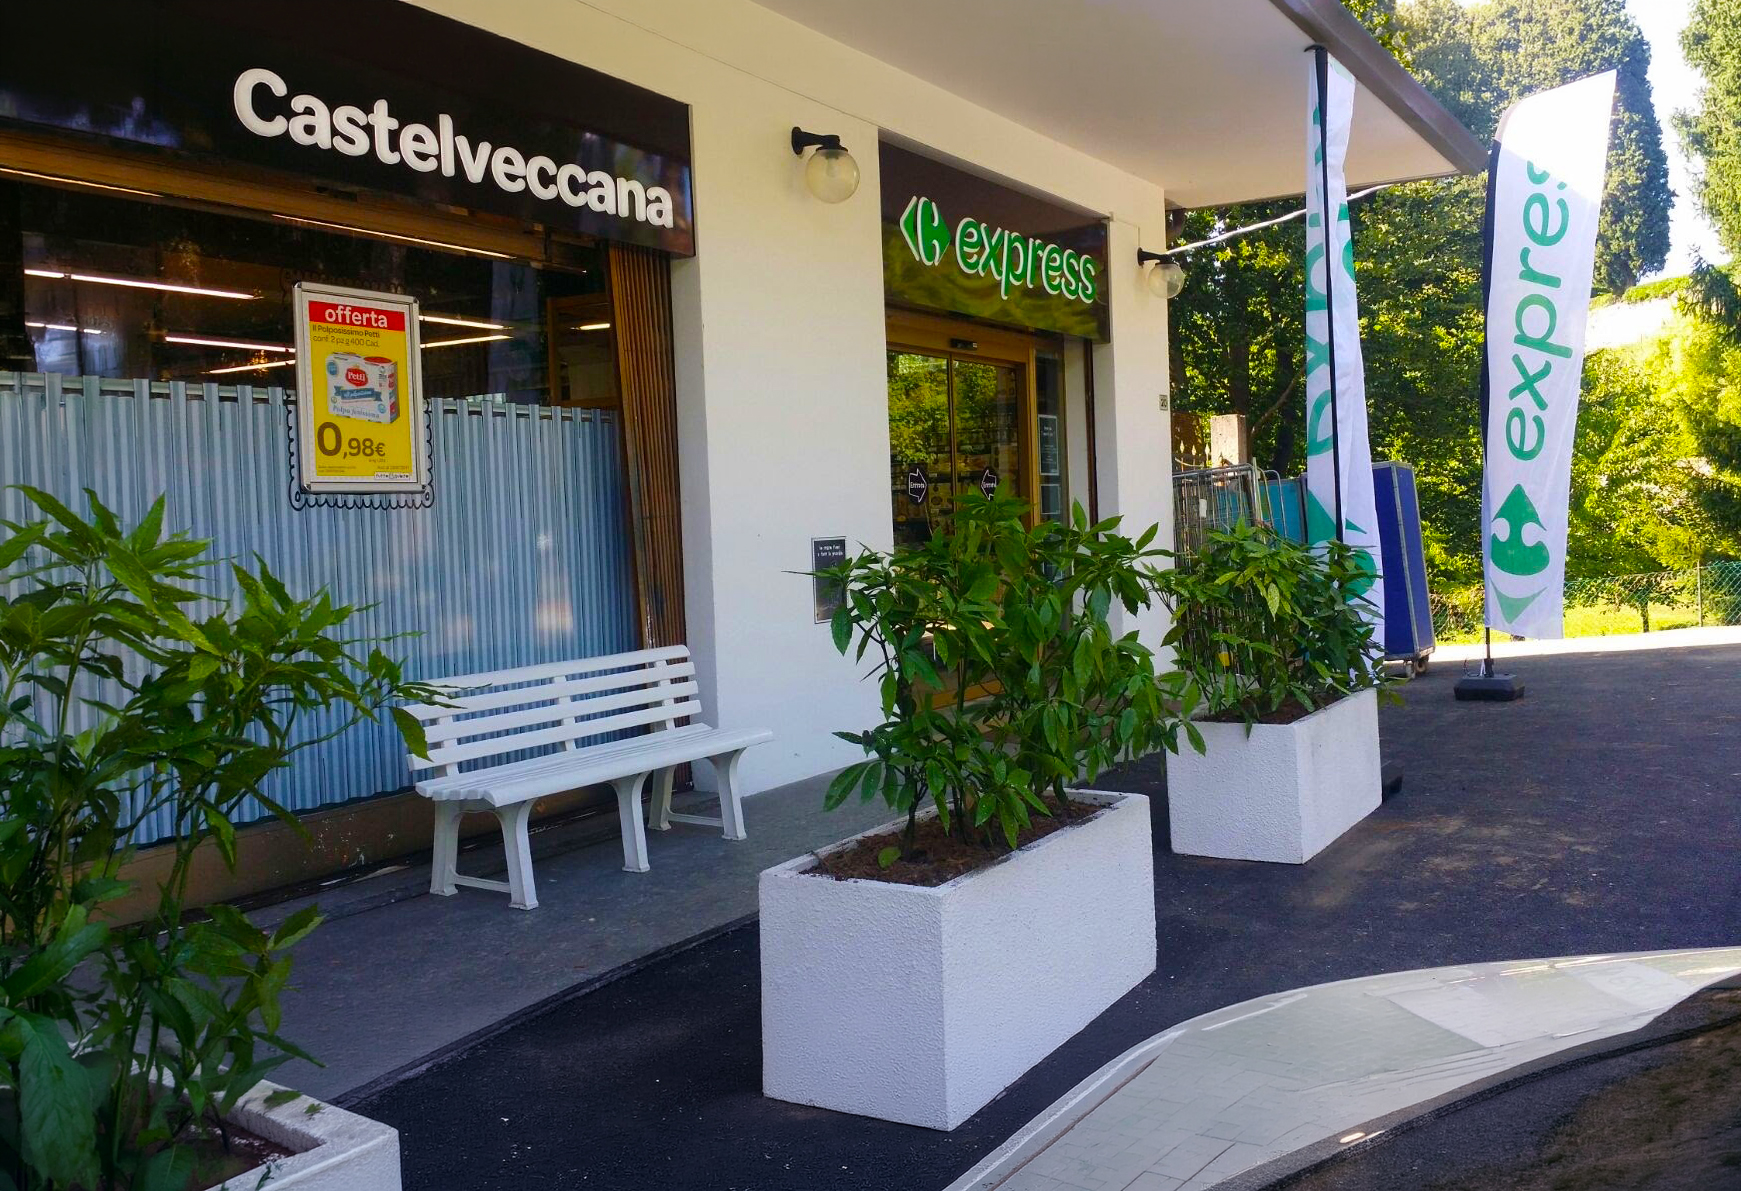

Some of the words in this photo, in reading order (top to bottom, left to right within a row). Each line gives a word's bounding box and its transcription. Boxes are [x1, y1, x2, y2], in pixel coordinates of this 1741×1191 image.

[233, 68, 674, 229] Castelveccana
[955, 217, 1096, 304] express
[318, 325, 364, 337] Polposissimo
[364, 329, 380, 338] Petti
[324, 305, 388, 328] offerta
[347, 371, 366, 381] Petti
[317, 422, 386, 460] 0,98€
